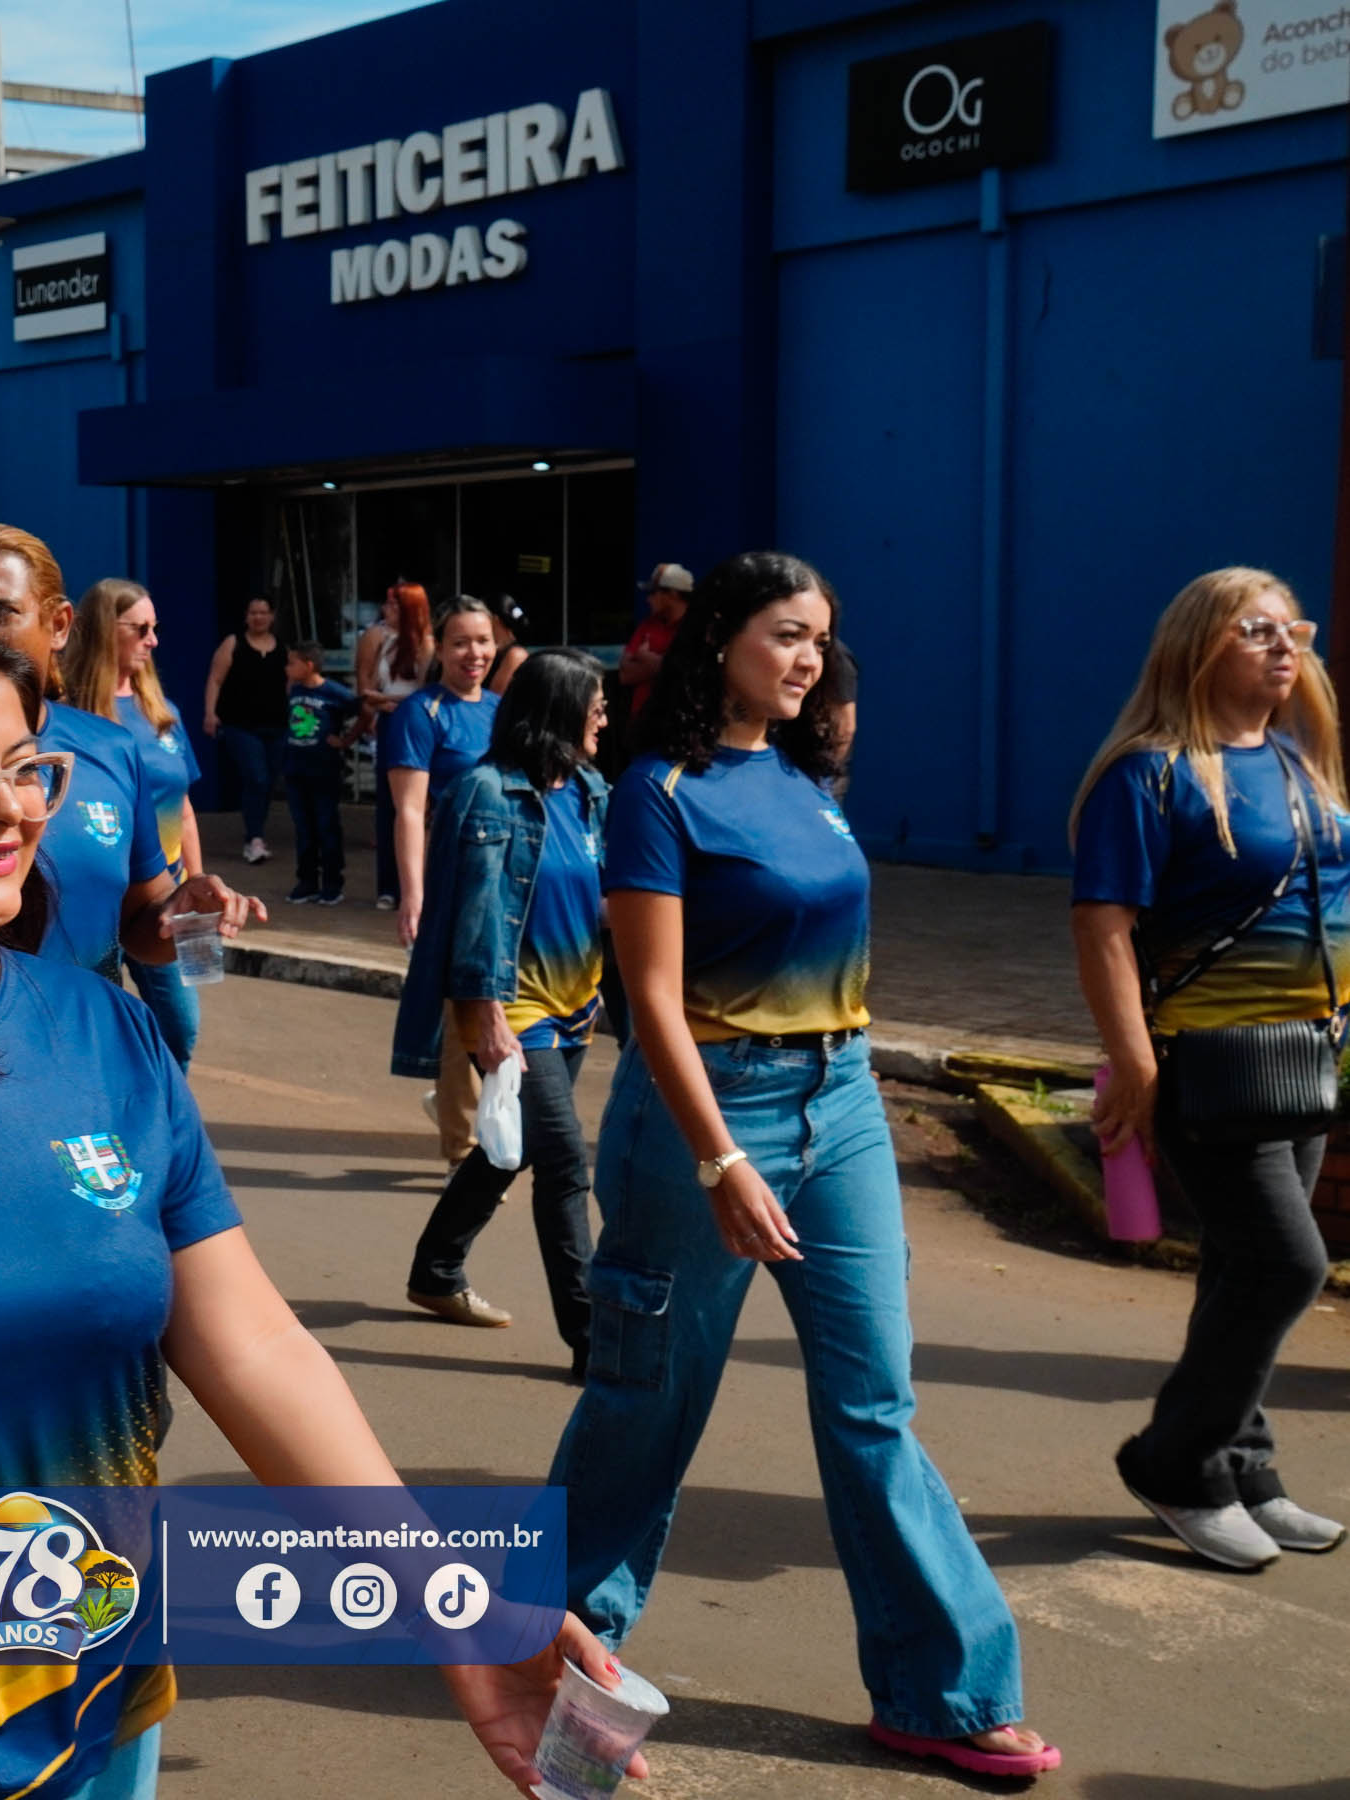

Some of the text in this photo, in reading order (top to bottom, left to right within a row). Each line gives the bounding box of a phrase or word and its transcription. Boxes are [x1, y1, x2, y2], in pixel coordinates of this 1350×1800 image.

[1261, 50, 1294, 73] do
[246, 87, 625, 246] FEITICEIRA
[901, 132, 980, 161] OGOCHI
[331, 218, 527, 304] MODAS
[16, 268, 100, 308] Lunender
